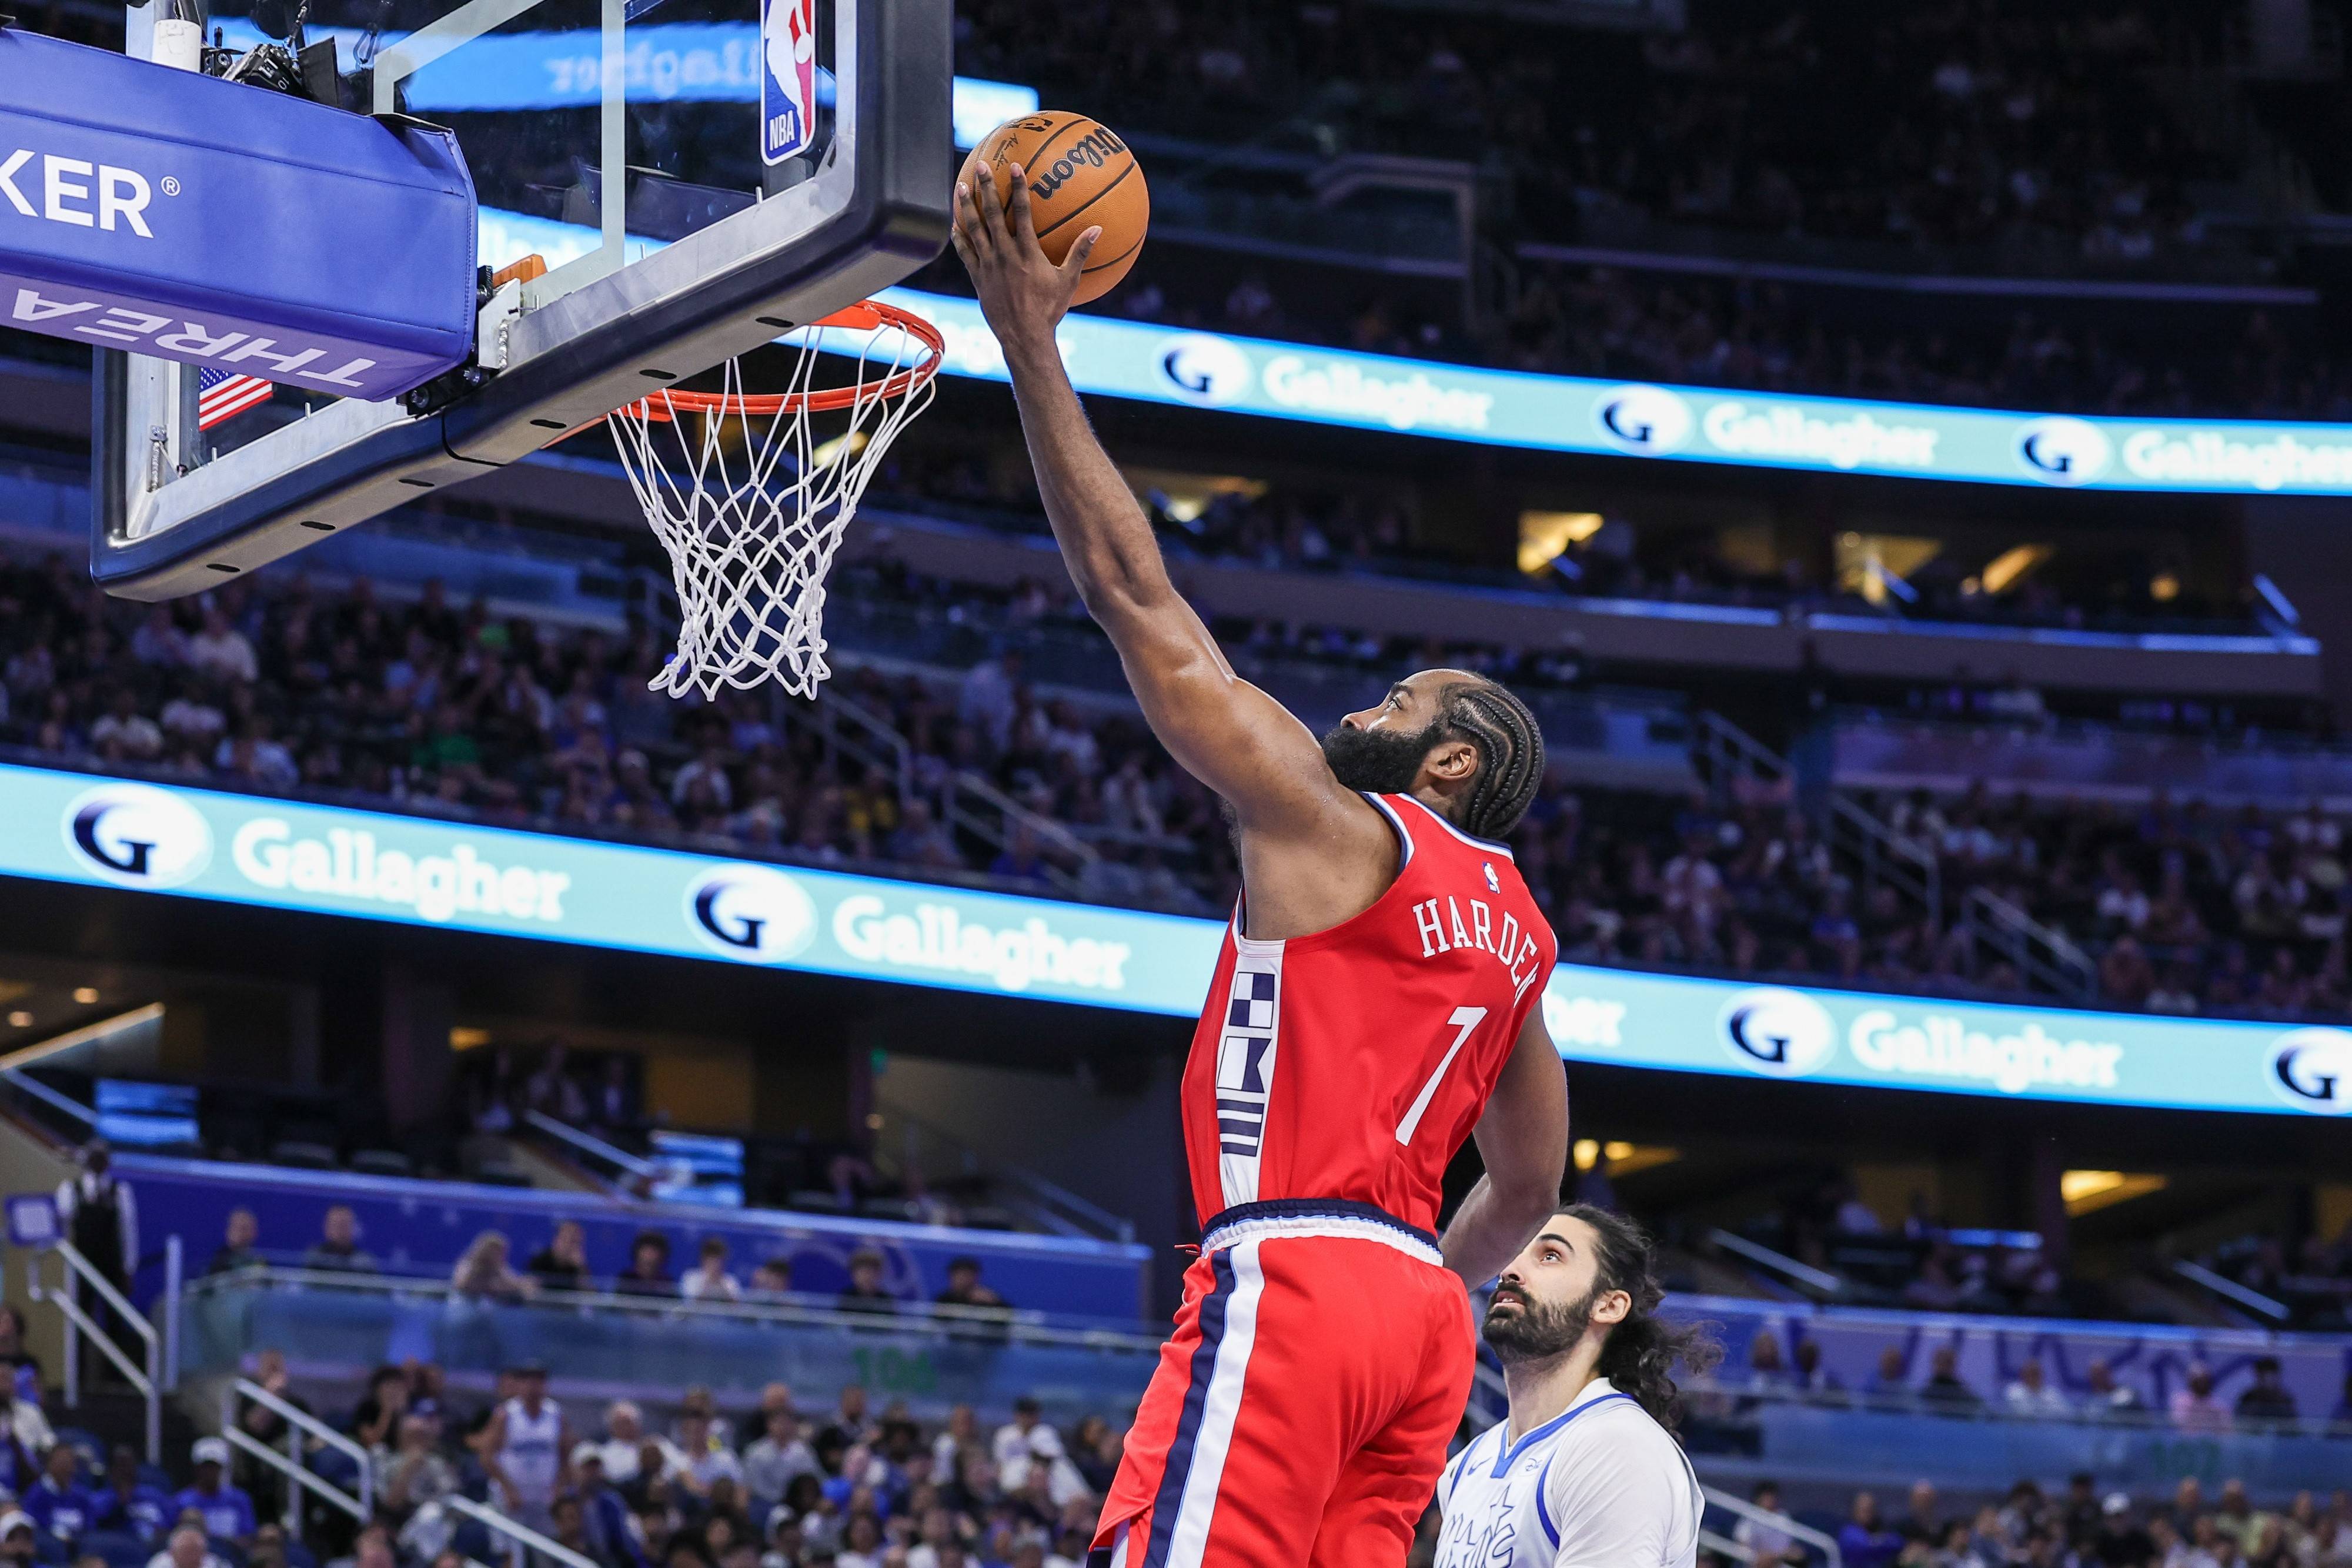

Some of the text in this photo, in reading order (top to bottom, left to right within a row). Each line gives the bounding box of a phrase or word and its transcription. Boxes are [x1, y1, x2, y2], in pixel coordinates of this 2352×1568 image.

[769, 109, 795, 151] NBA
[1030, 126, 1127, 200] Wilson
[232, 818, 570, 922] Gallagher
[833, 895, 1131, 991] Gallagher
[1412, 895, 1539, 1009] HARDEN
[1395, 1006, 1488, 1146] 7
[1849, 1011, 2123, 1093] Gallagher
